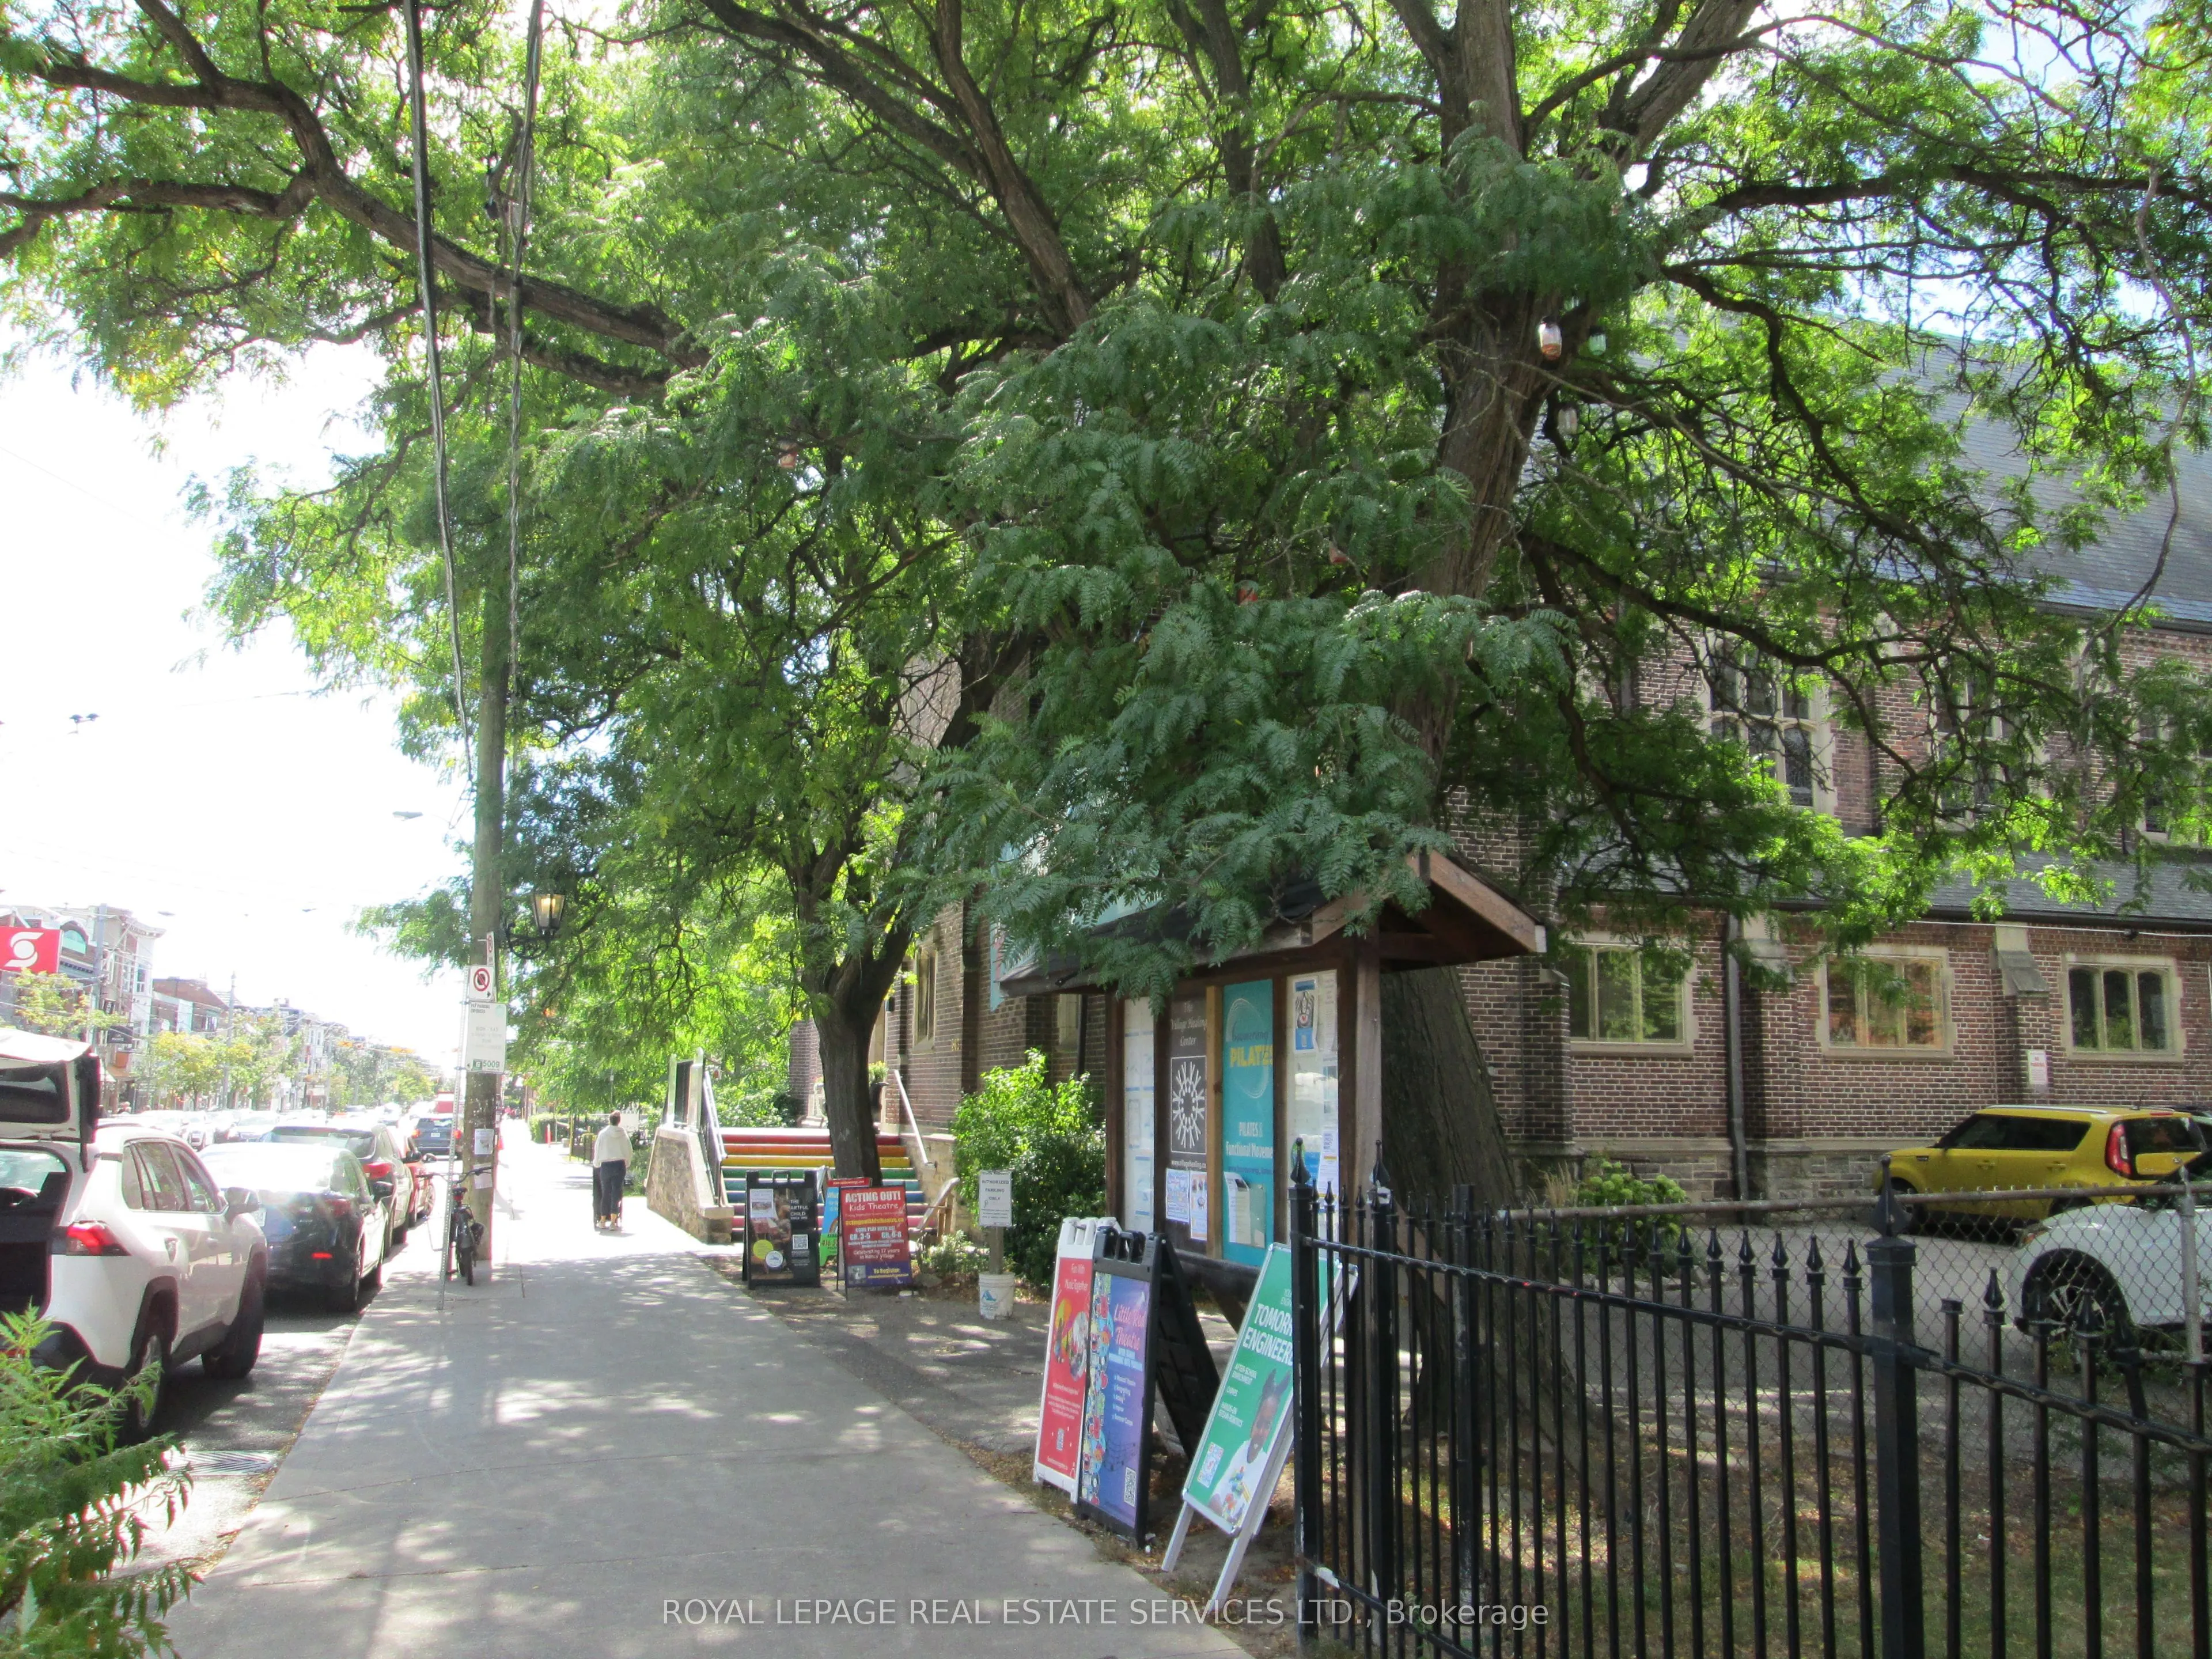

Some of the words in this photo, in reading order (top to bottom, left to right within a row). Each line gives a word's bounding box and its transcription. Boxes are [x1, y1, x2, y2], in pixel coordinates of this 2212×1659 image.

[483, 1060, 500, 1068] 5009
[1239, 1122, 1258, 1137] PILATES
[845, 1192, 878, 1203] ACTING
[880, 1191, 901, 1201] OUT!
[849, 1203, 865, 1211] Kids
[1113, 1303, 1130, 1324] Little
[1116, 1326, 1141, 1351] Theatre
